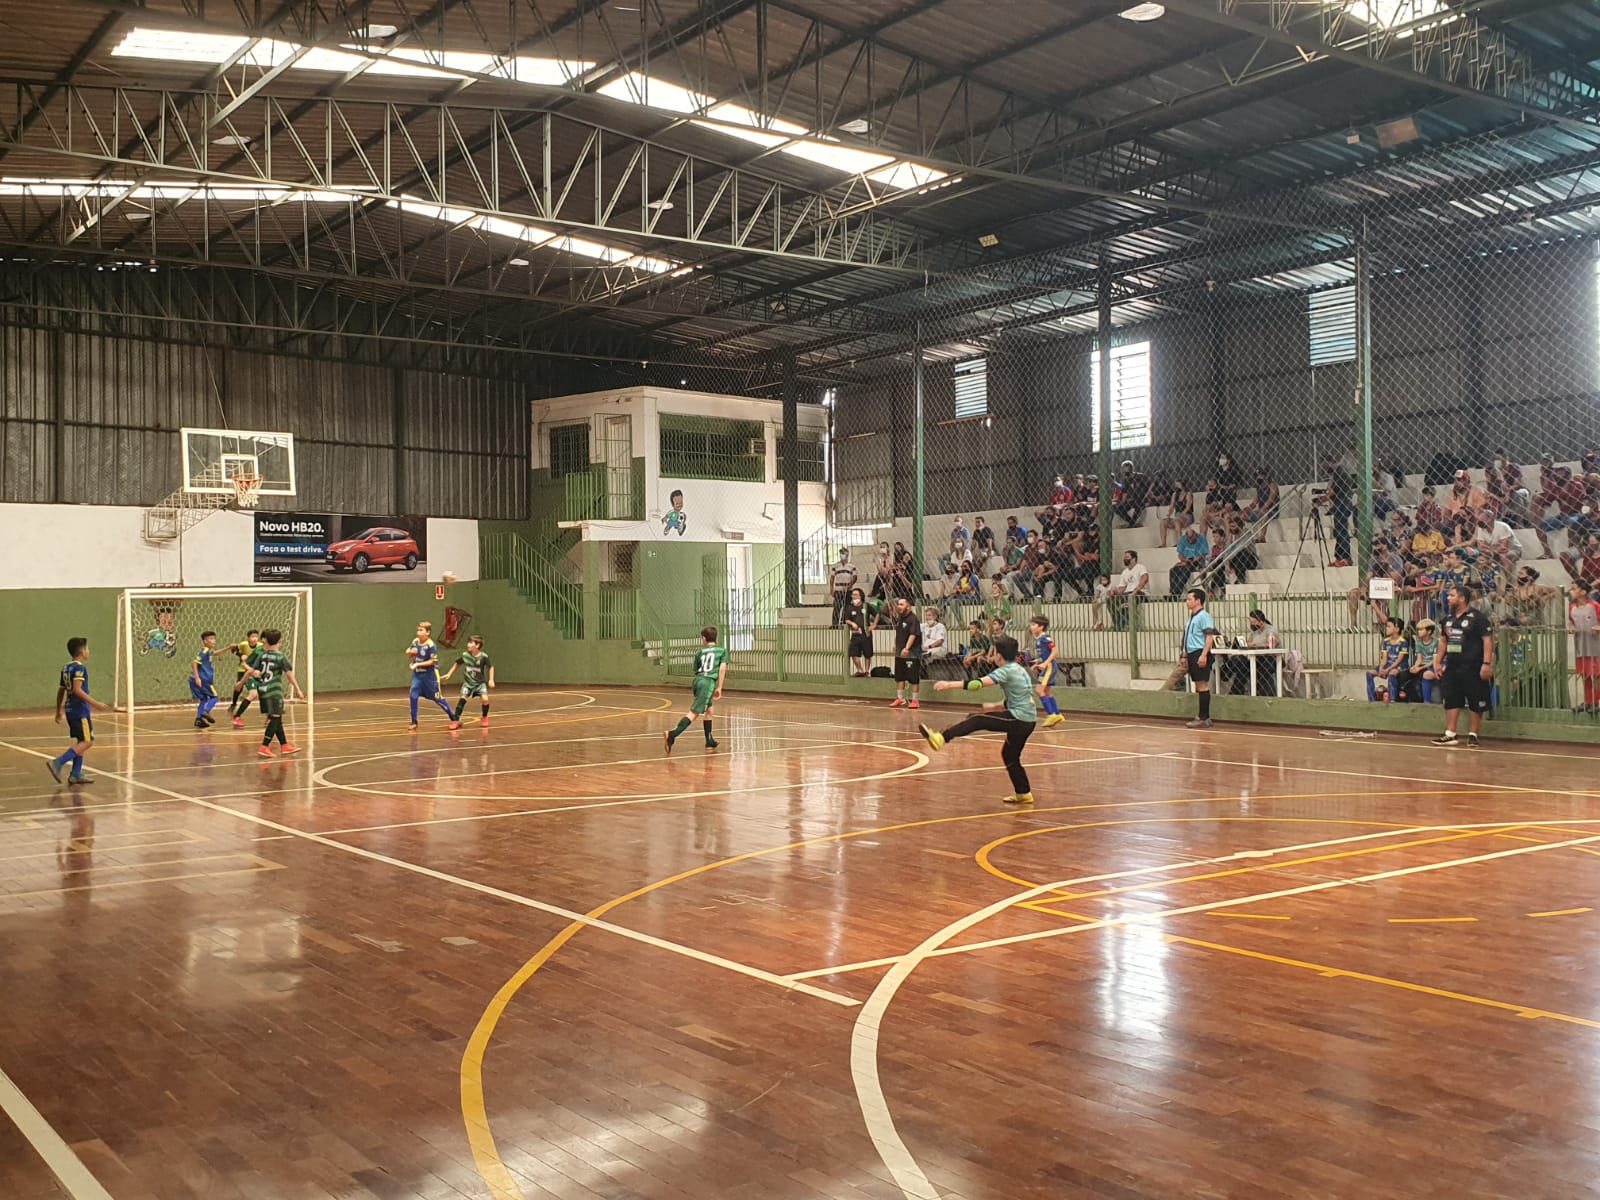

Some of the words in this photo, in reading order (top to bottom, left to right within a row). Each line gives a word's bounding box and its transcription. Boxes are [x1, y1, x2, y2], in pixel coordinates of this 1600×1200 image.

[259, 520, 290, 532] Novo
[291, 521, 325, 533] HB20.
[259, 545, 279, 553] Faça
[302, 545, 324, 553] drive.
[698, 651, 715, 673] 10
